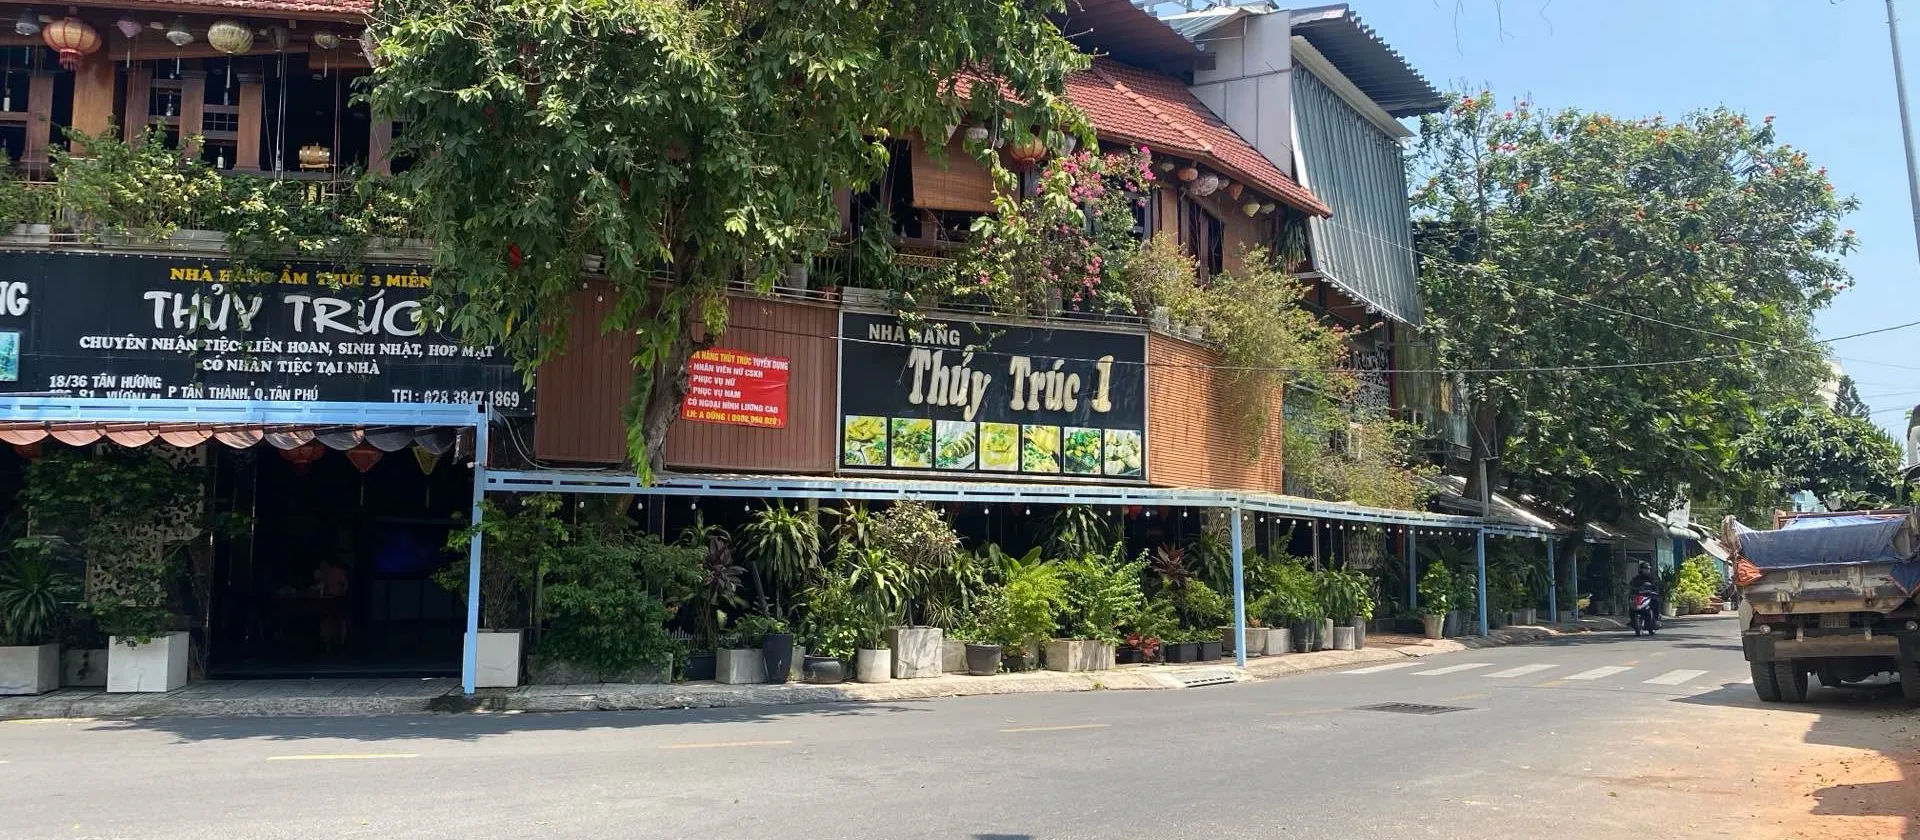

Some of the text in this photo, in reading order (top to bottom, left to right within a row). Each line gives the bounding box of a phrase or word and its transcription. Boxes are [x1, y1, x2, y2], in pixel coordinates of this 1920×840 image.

[170, 264, 214, 282] NHÀ
[370, 274, 381, 287] 3
[144, 283, 263, 334] THỦY
[79, 333, 148, 350] CHUYÊN
[151, 335, 198, 353] NHẬN
[246, 337, 283, 353] LIÊN
[287, 341, 333, 356] HOAN,
[338, 342, 375, 355] SINH
[379, 341, 424, 358] NHẬT,
[202, 355, 223, 371] CÓ
[277, 357, 313, 376] TIỆC
[316, 360, 344, 376] TẠI
[347, 359, 381, 375] NHÀ
[694, 362, 714, 373] NHÂN
[716, 365, 732, 375] VIÊN
[745, 369, 763, 379] CSKH
[50, 373, 163, 389] 18/36 TÂN HƯƠNG
[693, 374, 713, 385] PHỤC
[714, 377, 723, 386] VỤ
[1009, 355, 1081, 412] Trúc
[1090, 355, 1115, 413] 1
[181, 383, 203, 399] TÂN
[294, 385, 319, 401] PHÚ
[693, 386, 741, 399] PHỤC VỤ NAM
[687, 397, 697, 406] CÓ
[699, 399, 720, 410] NGOẠI
[722, 400, 739, 410] HÌNH
[765, 405, 778, 414] CAO
[699, 410, 704, 418] A
